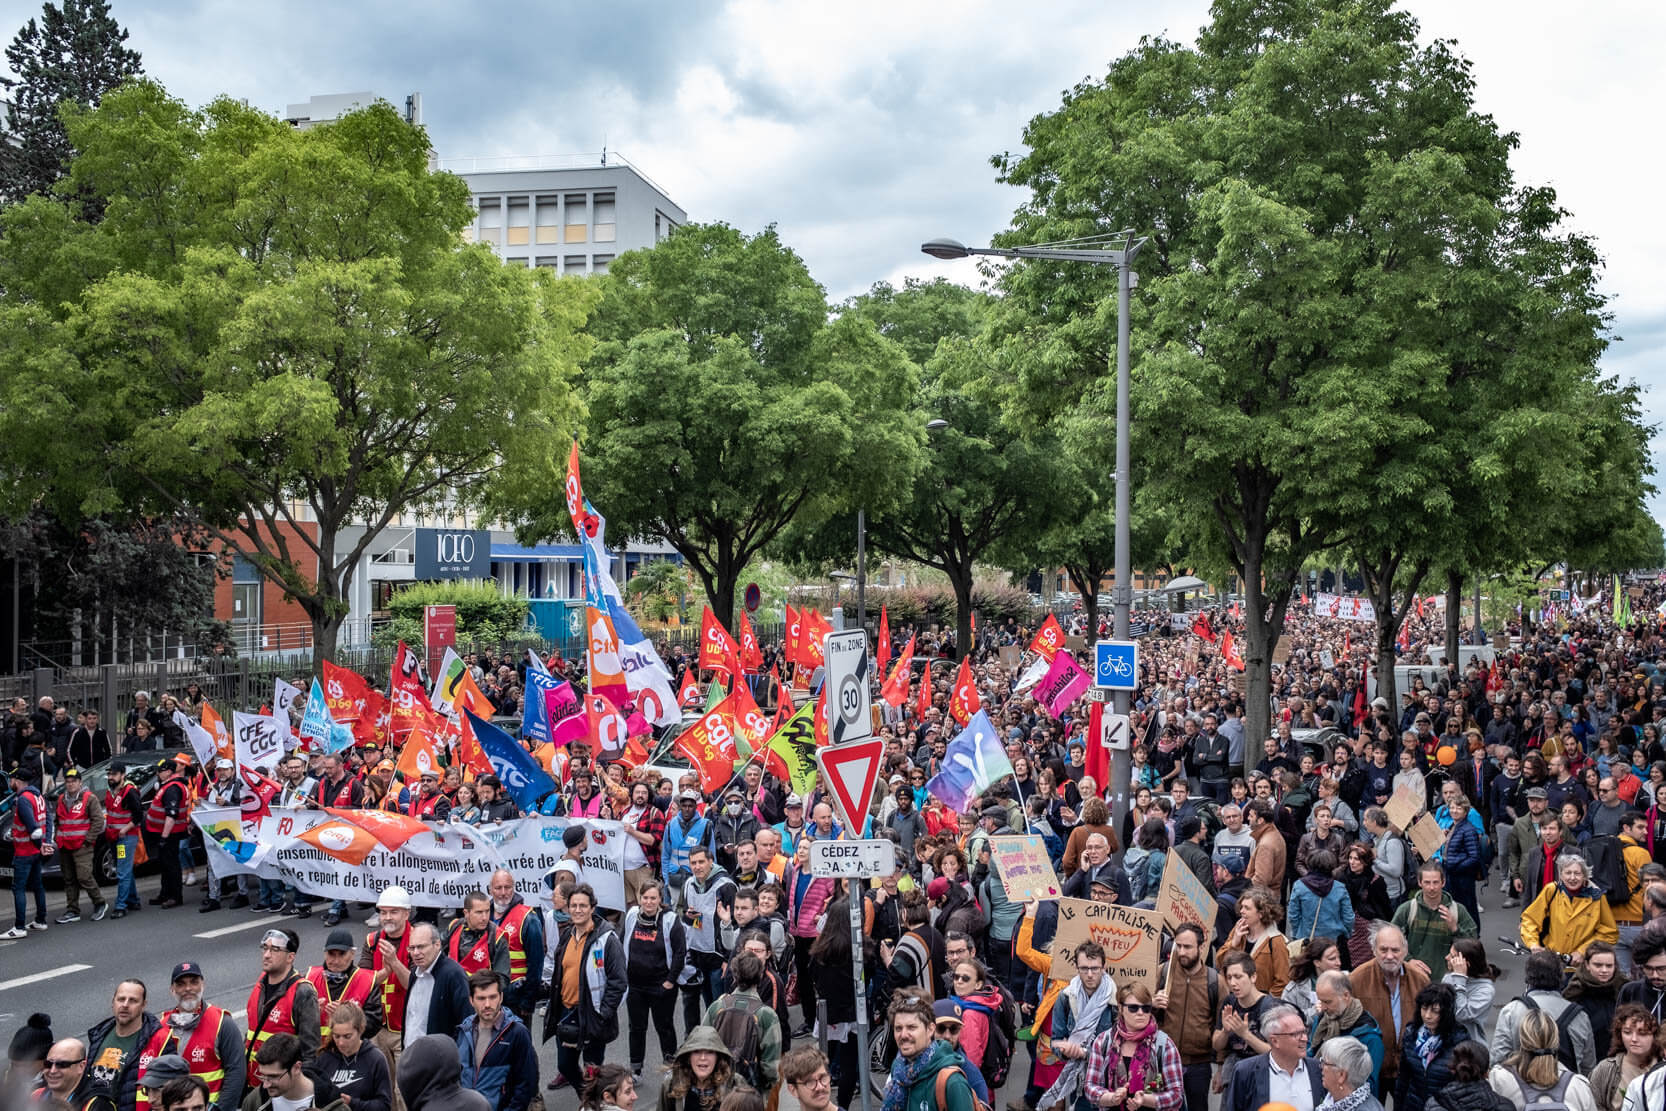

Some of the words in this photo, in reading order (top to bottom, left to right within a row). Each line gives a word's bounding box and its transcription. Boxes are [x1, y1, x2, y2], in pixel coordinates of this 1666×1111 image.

[437, 534, 475, 563] ICEO
[831, 641, 841, 653] FIN
[848, 638, 864, 650] ZONE
[843, 688, 858, 710] 30
[240, 721, 264, 743] CFE
[250, 730, 276, 755] CGC
[692, 726, 708, 745] UD
[277, 816, 294, 836] FO
[821, 844, 859, 858] CÉDEZ
[381, 852, 461, 873] l'allongement
[478, 859, 492, 873] la
[538, 853, 554, 870] de
[309, 870, 339, 886] report
[343, 872, 359, 888] de
[429, 877, 440, 894] de
[443, 880, 482, 899] départ
[1061, 906, 1076, 920] LE
